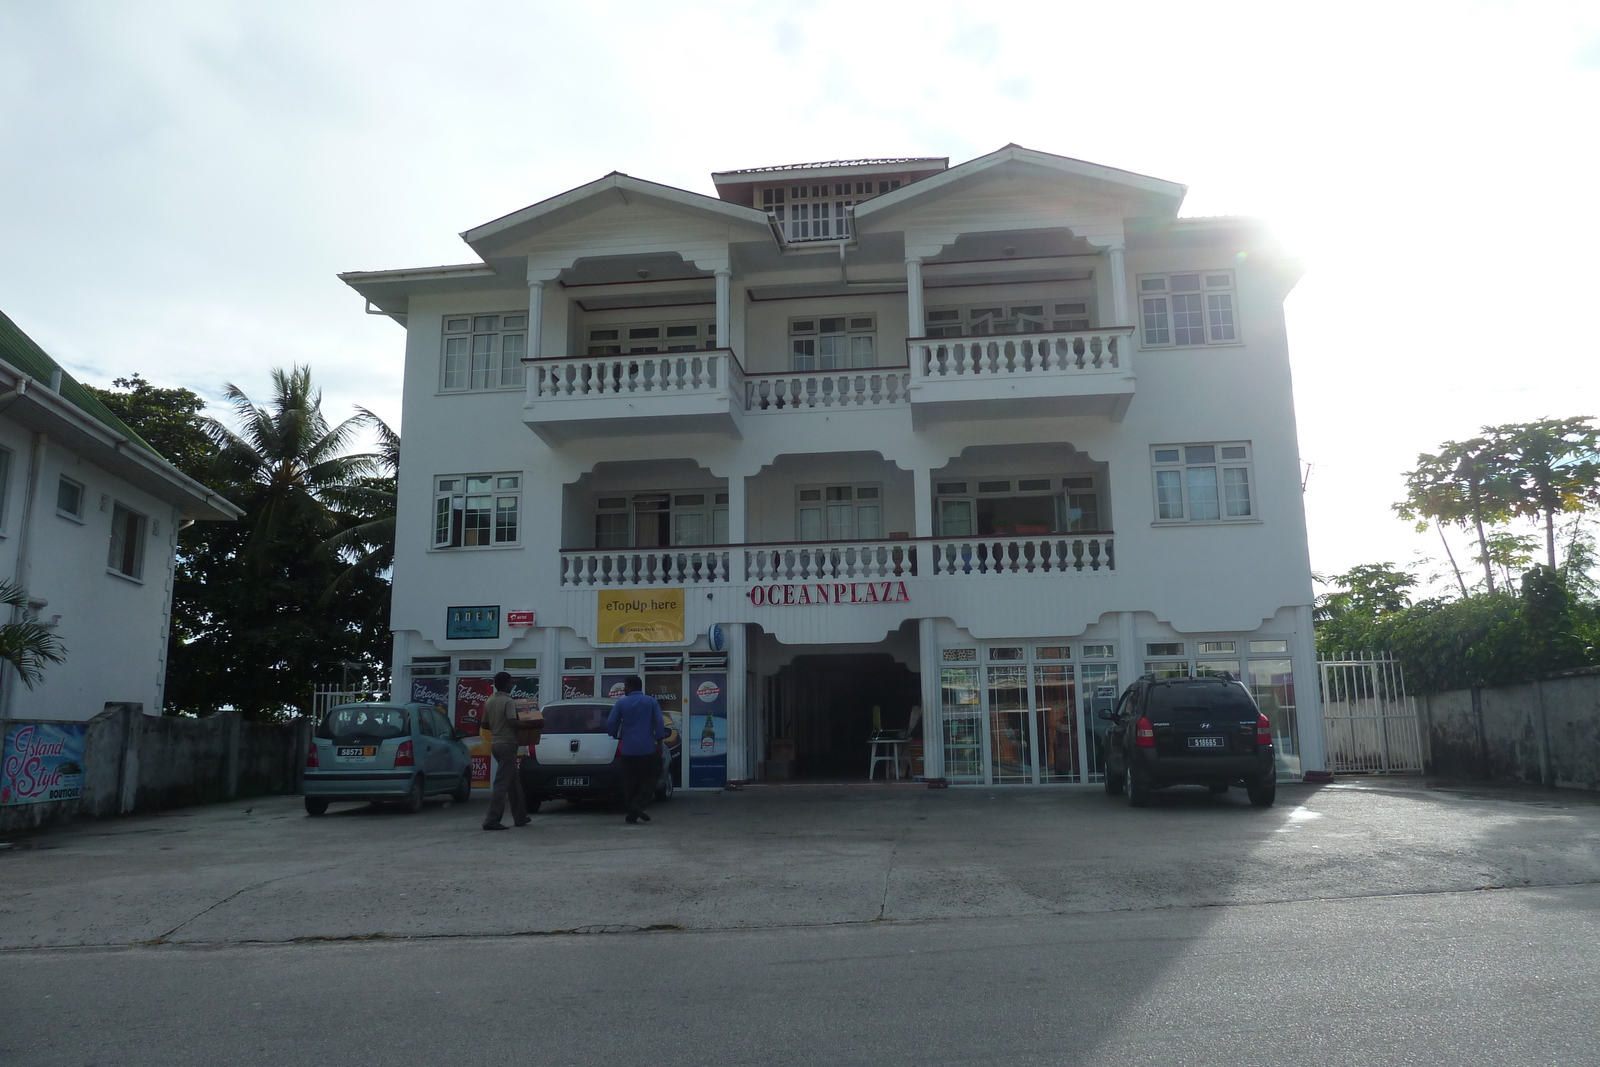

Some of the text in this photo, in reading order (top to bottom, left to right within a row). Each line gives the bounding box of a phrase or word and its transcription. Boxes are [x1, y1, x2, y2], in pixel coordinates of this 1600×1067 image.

[606, 599, 677, 613] eTopUp here
[454, 610, 495, 622] ADEN
[341, 748, 363, 756] S8573
[17, 756, 63, 798] Style
[49, 788, 79, 799] BOUTIQUE
